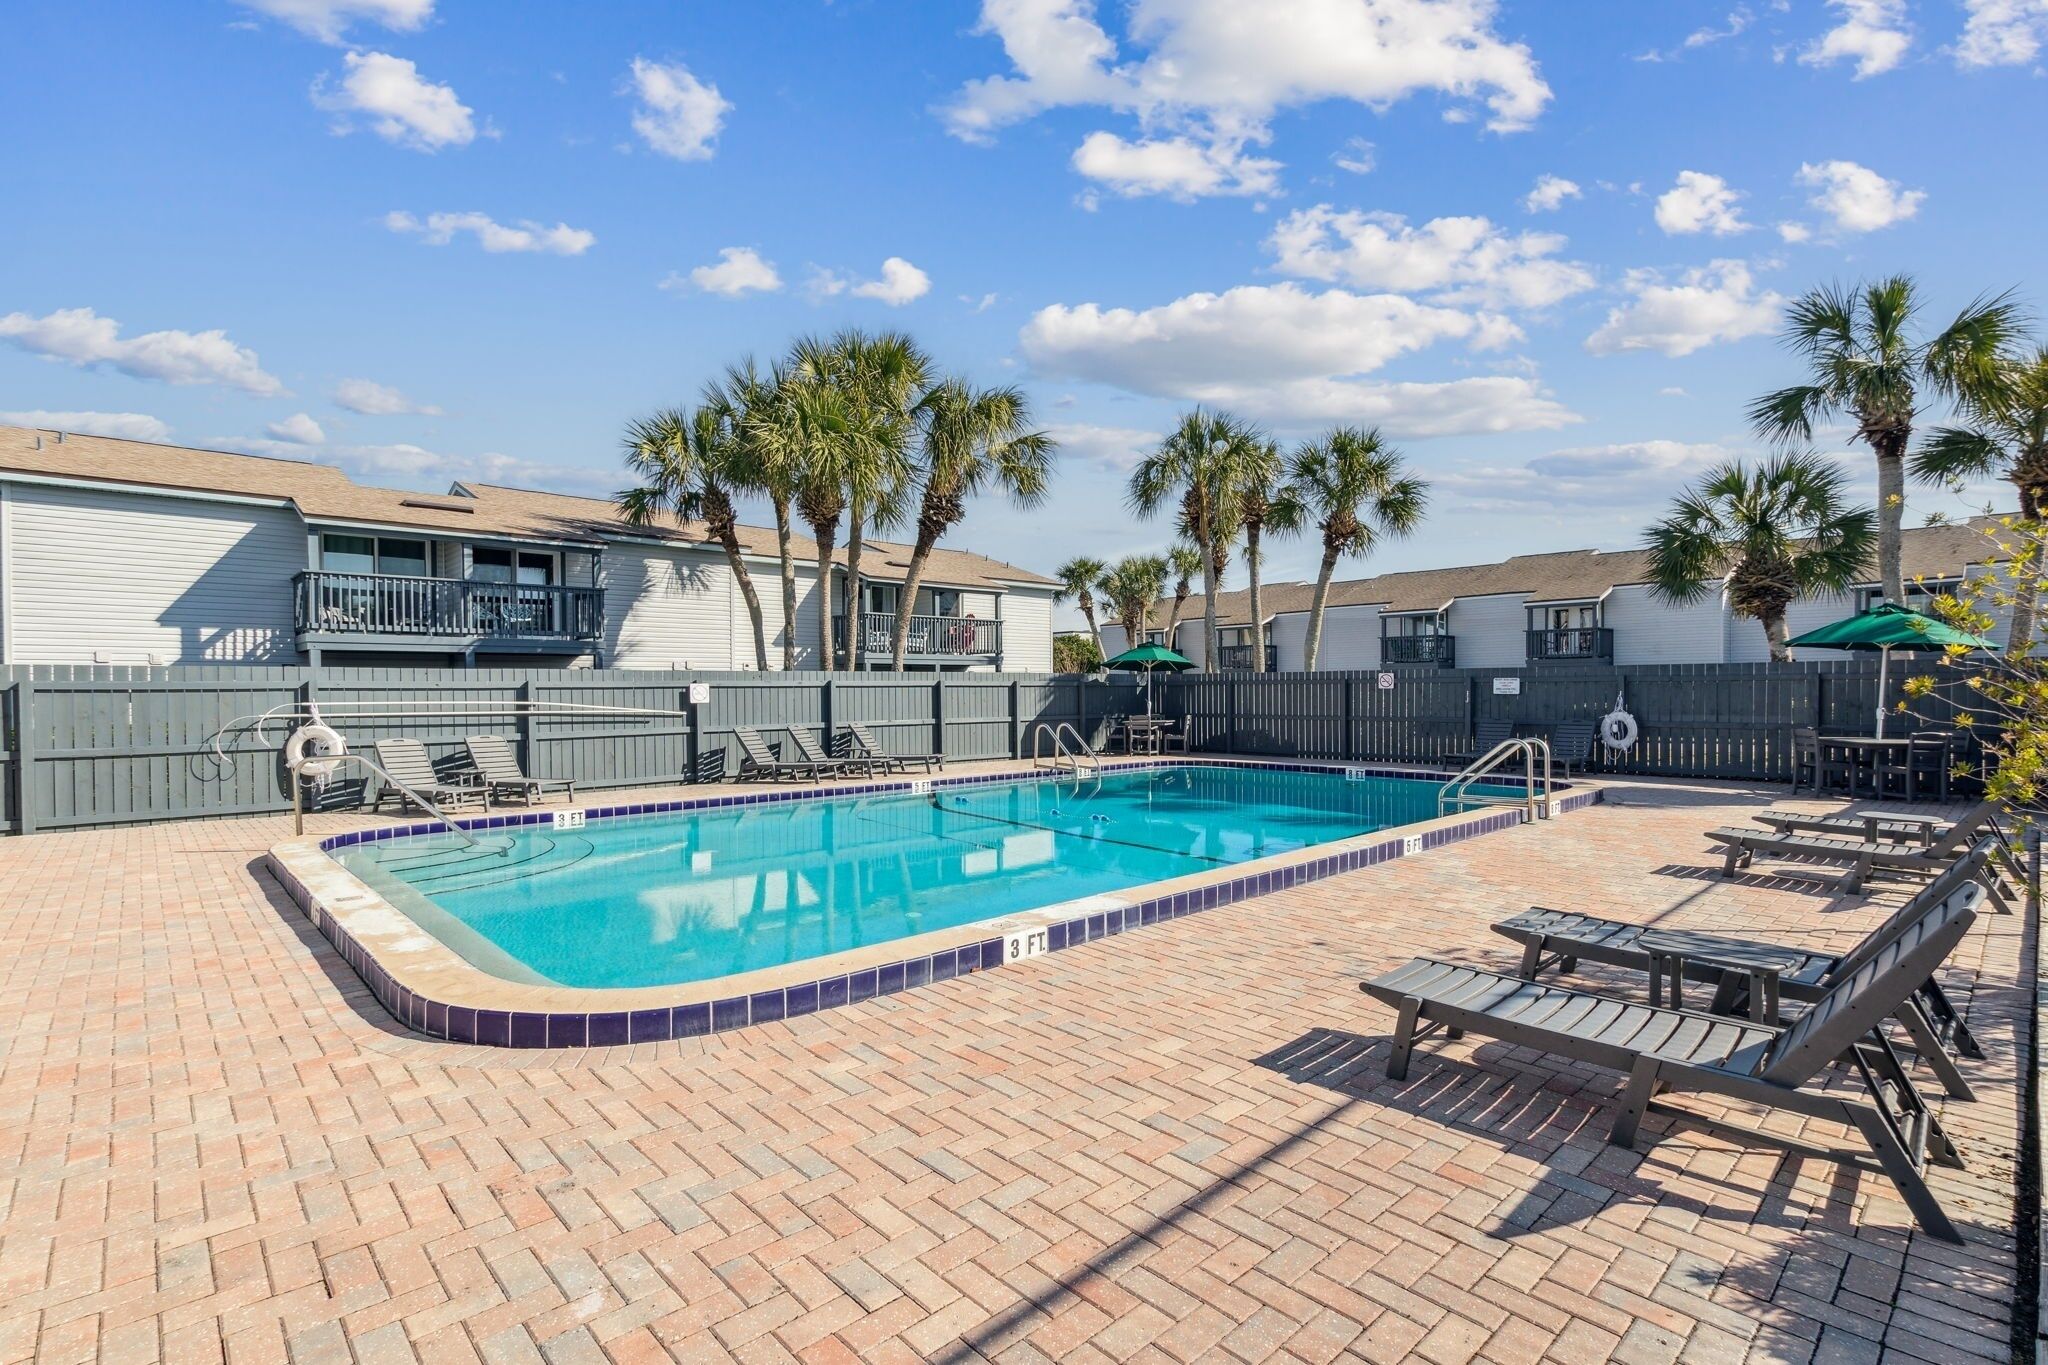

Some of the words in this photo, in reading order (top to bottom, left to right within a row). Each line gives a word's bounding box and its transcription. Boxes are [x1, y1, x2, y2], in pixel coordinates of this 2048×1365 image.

[558, 813, 566, 828] 3
[1010, 938, 1020, 959] 3
[1027, 931, 1046, 955] FT.
